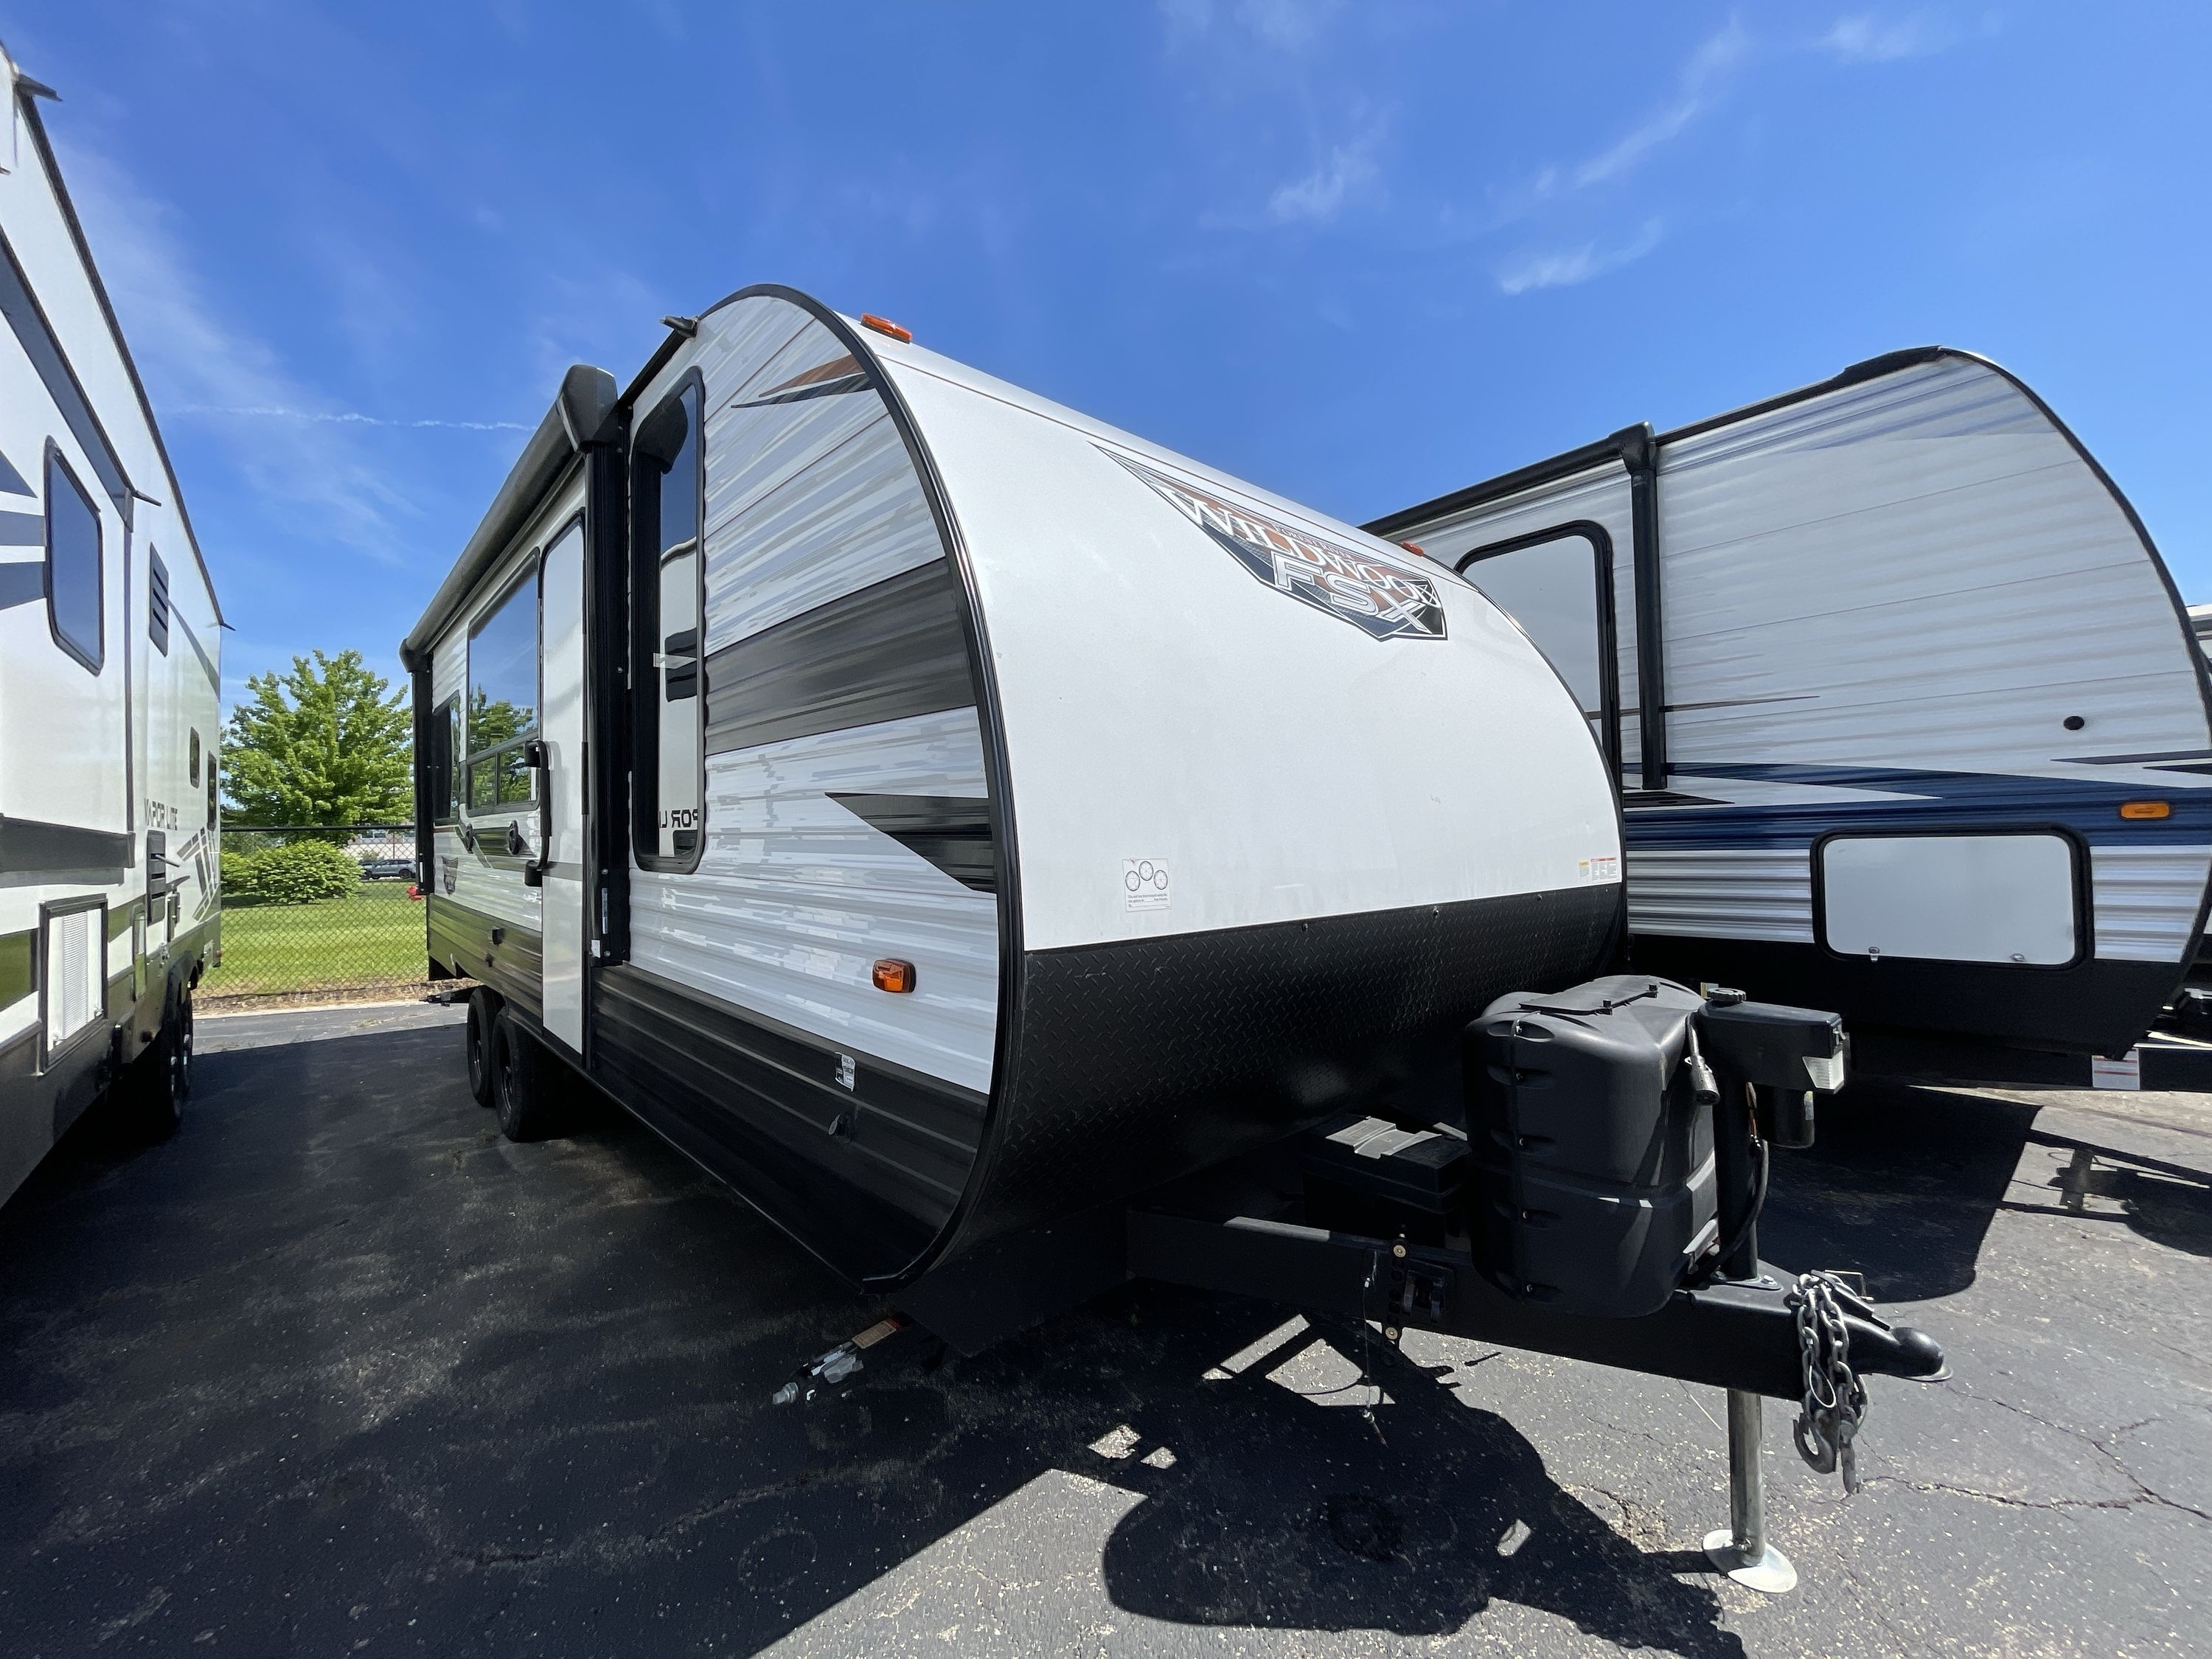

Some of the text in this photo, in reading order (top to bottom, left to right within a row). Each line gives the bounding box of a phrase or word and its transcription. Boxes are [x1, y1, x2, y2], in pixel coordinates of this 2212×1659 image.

[1163, 487, 1441, 609] WILDWOOD
[1273, 522, 1318, 546] FOREST
[1271, 550, 1433, 636] FSX
